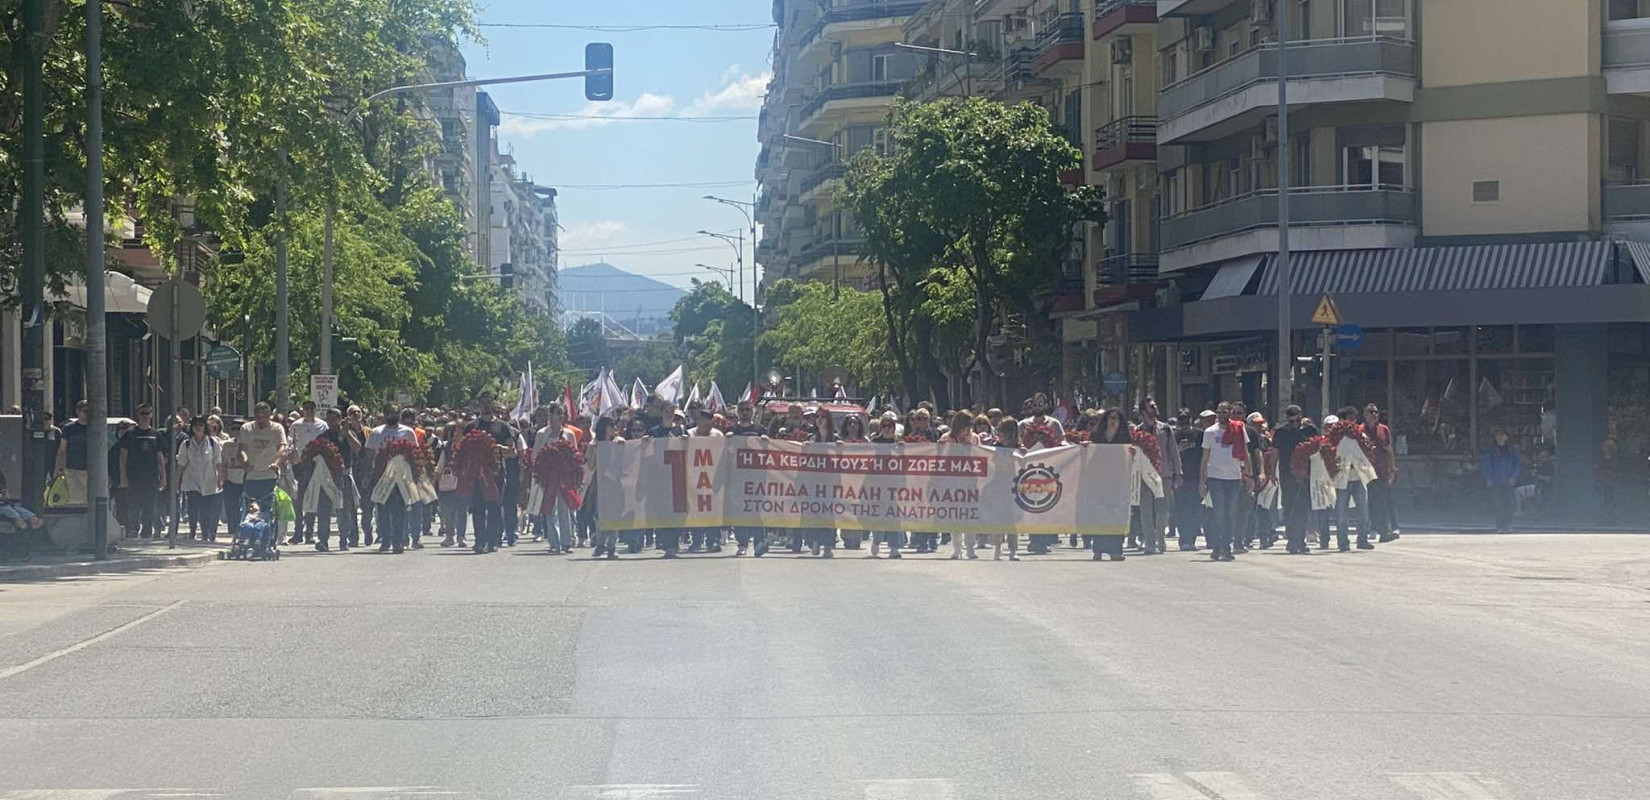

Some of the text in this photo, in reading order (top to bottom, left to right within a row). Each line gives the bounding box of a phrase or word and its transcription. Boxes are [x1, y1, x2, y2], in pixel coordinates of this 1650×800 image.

[758, 453, 775, 466] ΤΑ
[780, 454, 826, 469] ΚΕΡΔΗ
[831, 457, 869, 470] ΤΟΥΣ
[888, 459, 903, 471] ΟΙ
[907, 460, 946, 472] ΖΩΕΣ
[951, 462, 982, 473] ΜΑΣ
[664, 450, 687, 513] 1
[744, 482, 979, 503] ΕΛΠΙΔΑ Η ΠΑΛΗ ΤΩΝ ΛΑΩΝ
[743, 500, 979, 520] ΣΤΟΝ ΔΡΟΜΟ ΤΗΣ ΑΝΑΤΡΟΠΗΣ
